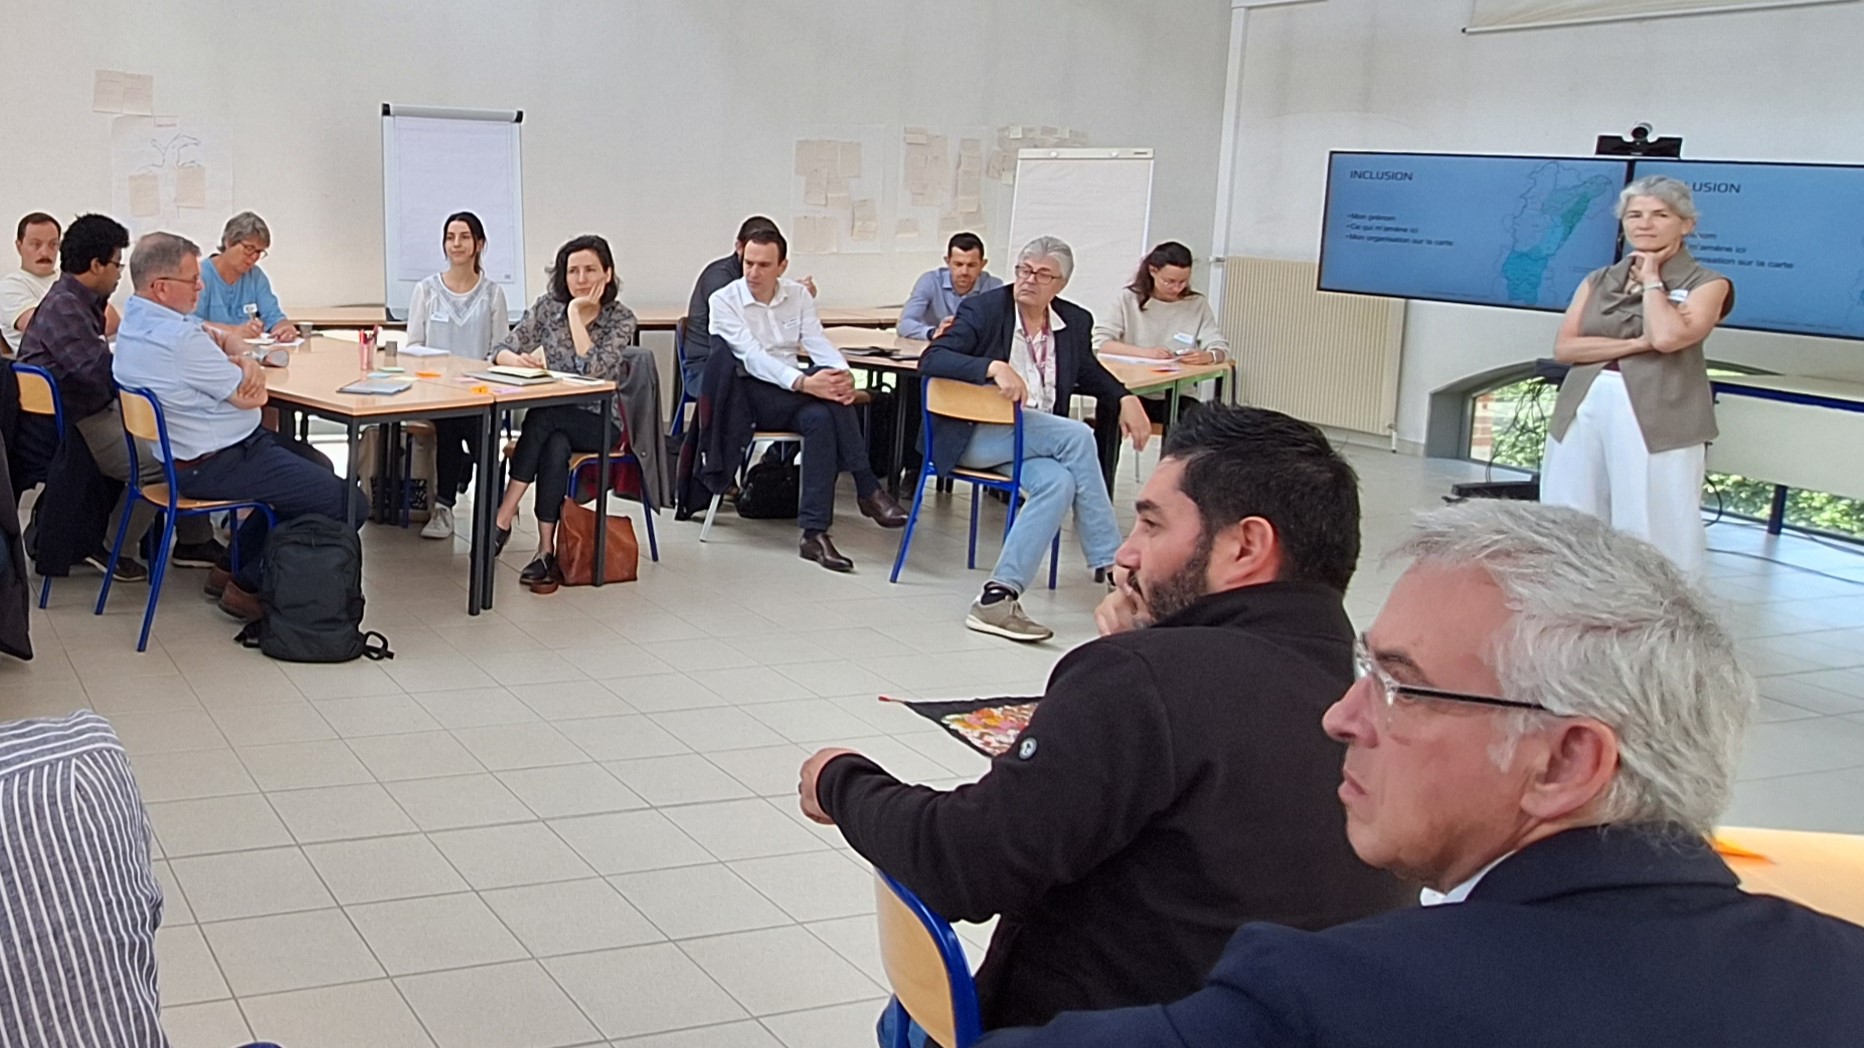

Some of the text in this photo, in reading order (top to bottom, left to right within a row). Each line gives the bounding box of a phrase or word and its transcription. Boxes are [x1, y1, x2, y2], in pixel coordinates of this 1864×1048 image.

[1350, 170, 1413, 181] INCLUSION
[1685, 181, 1741, 194] USION
[1737, 259, 1754, 267] sur
[1767, 261, 1795, 270] carte
